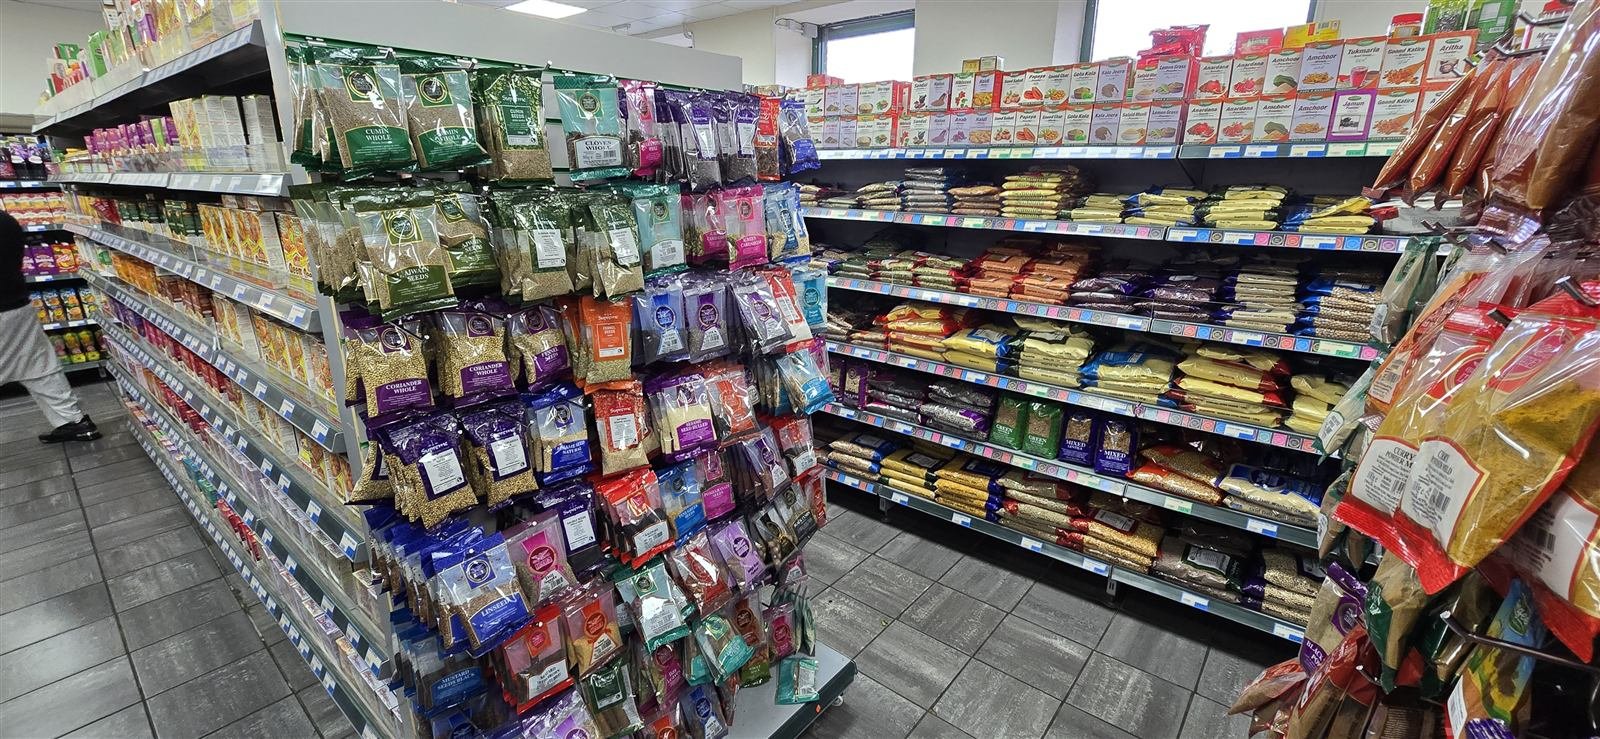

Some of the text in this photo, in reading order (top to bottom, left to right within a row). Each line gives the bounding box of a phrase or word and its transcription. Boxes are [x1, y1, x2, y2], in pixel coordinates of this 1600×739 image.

[1347, 47, 1380, 55] Tukmaria
[1440, 43, 1464, 53] Aritha
[1306, 53, 1337, 61] Amchoor
[365, 127, 389, 136] CUMIN
[365, 133, 391, 141] WHOLE
[408, 274, 429, 282] SEEDS
[541, 347, 559, 357] FENNEL
[544, 352, 560, 361] SEEDS
[469, 363, 503, 372] CORIANDER
[476, 368, 498, 376] WHOLE
[385, 380, 422, 391] CORIANDER
[393, 386, 417, 394] WHOLE
[609, 406, 632, 414] Supreme
[996, 424, 1013, 432] GREEN
[421, 441, 448, 454] Supreme
[1065, 439, 1086, 448] MIXED
[562, 446, 582, 454] NATURAL
[1104, 450, 1126, 458] MIXED
[1394, 447, 1416, 461] CURRY
[1385, 451, 1404, 466] POWDER
[562, 503, 585, 515] Supreme
[481, 600, 510, 616] LINSEED
[436, 672, 475, 689] SEEDS BLACK
[441, 670, 471, 683] MUSTARD
